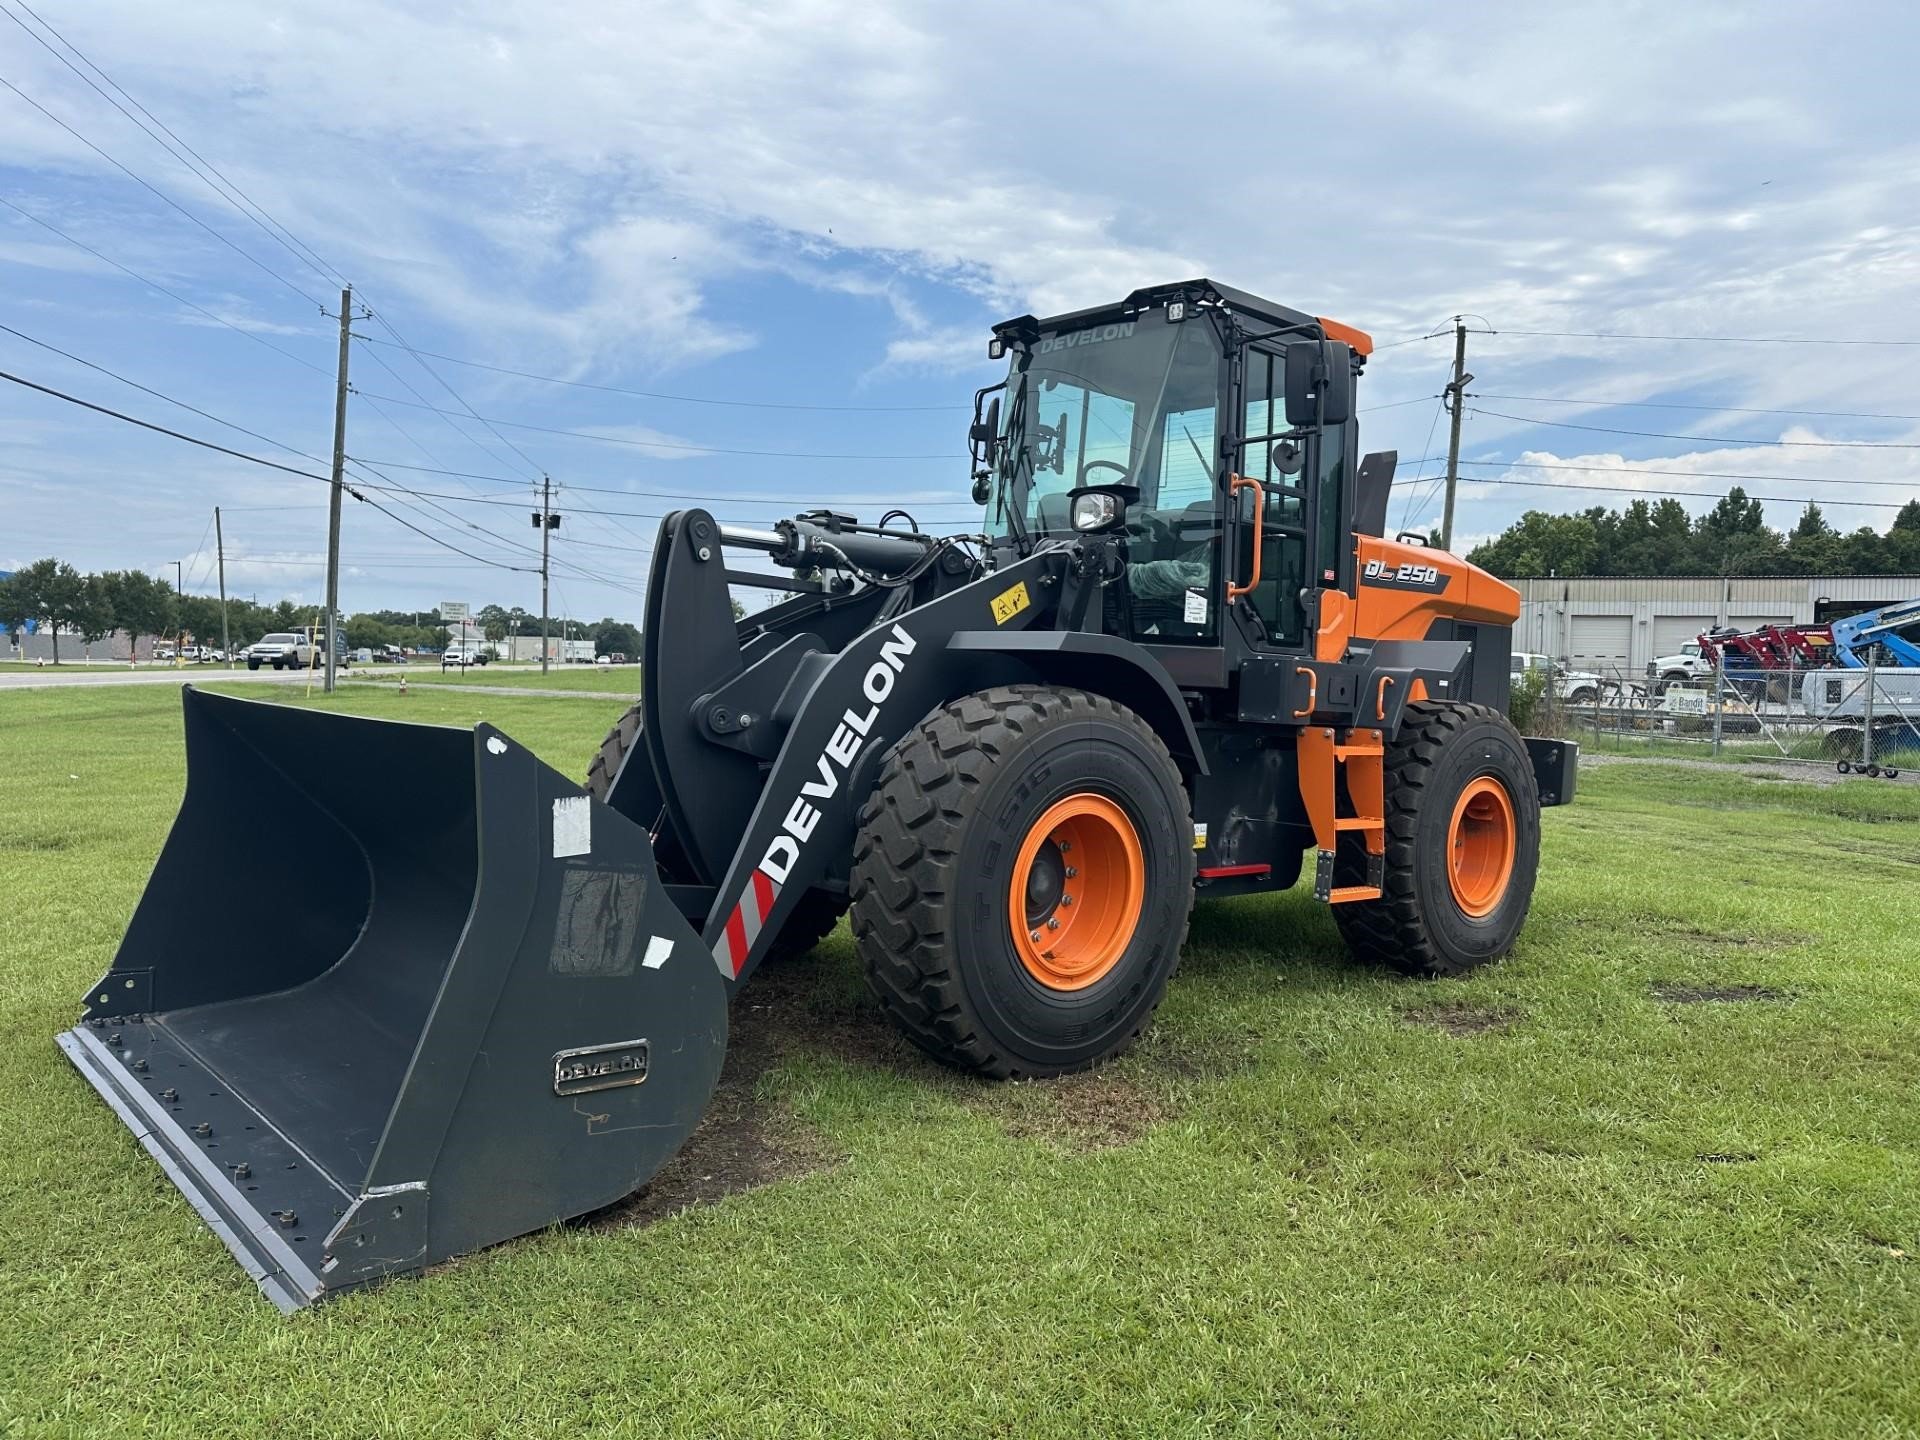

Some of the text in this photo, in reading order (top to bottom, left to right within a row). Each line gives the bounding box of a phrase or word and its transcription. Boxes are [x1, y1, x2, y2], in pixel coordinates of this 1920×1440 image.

[1041, 322, 1136, 354] DEVELON
[1365, 560, 1438, 585] DL 250
[1679, 697, 1703, 708] Bandit
[759, 624, 917, 884] DEVELON
[560, 1056, 646, 1082] DEVELON
